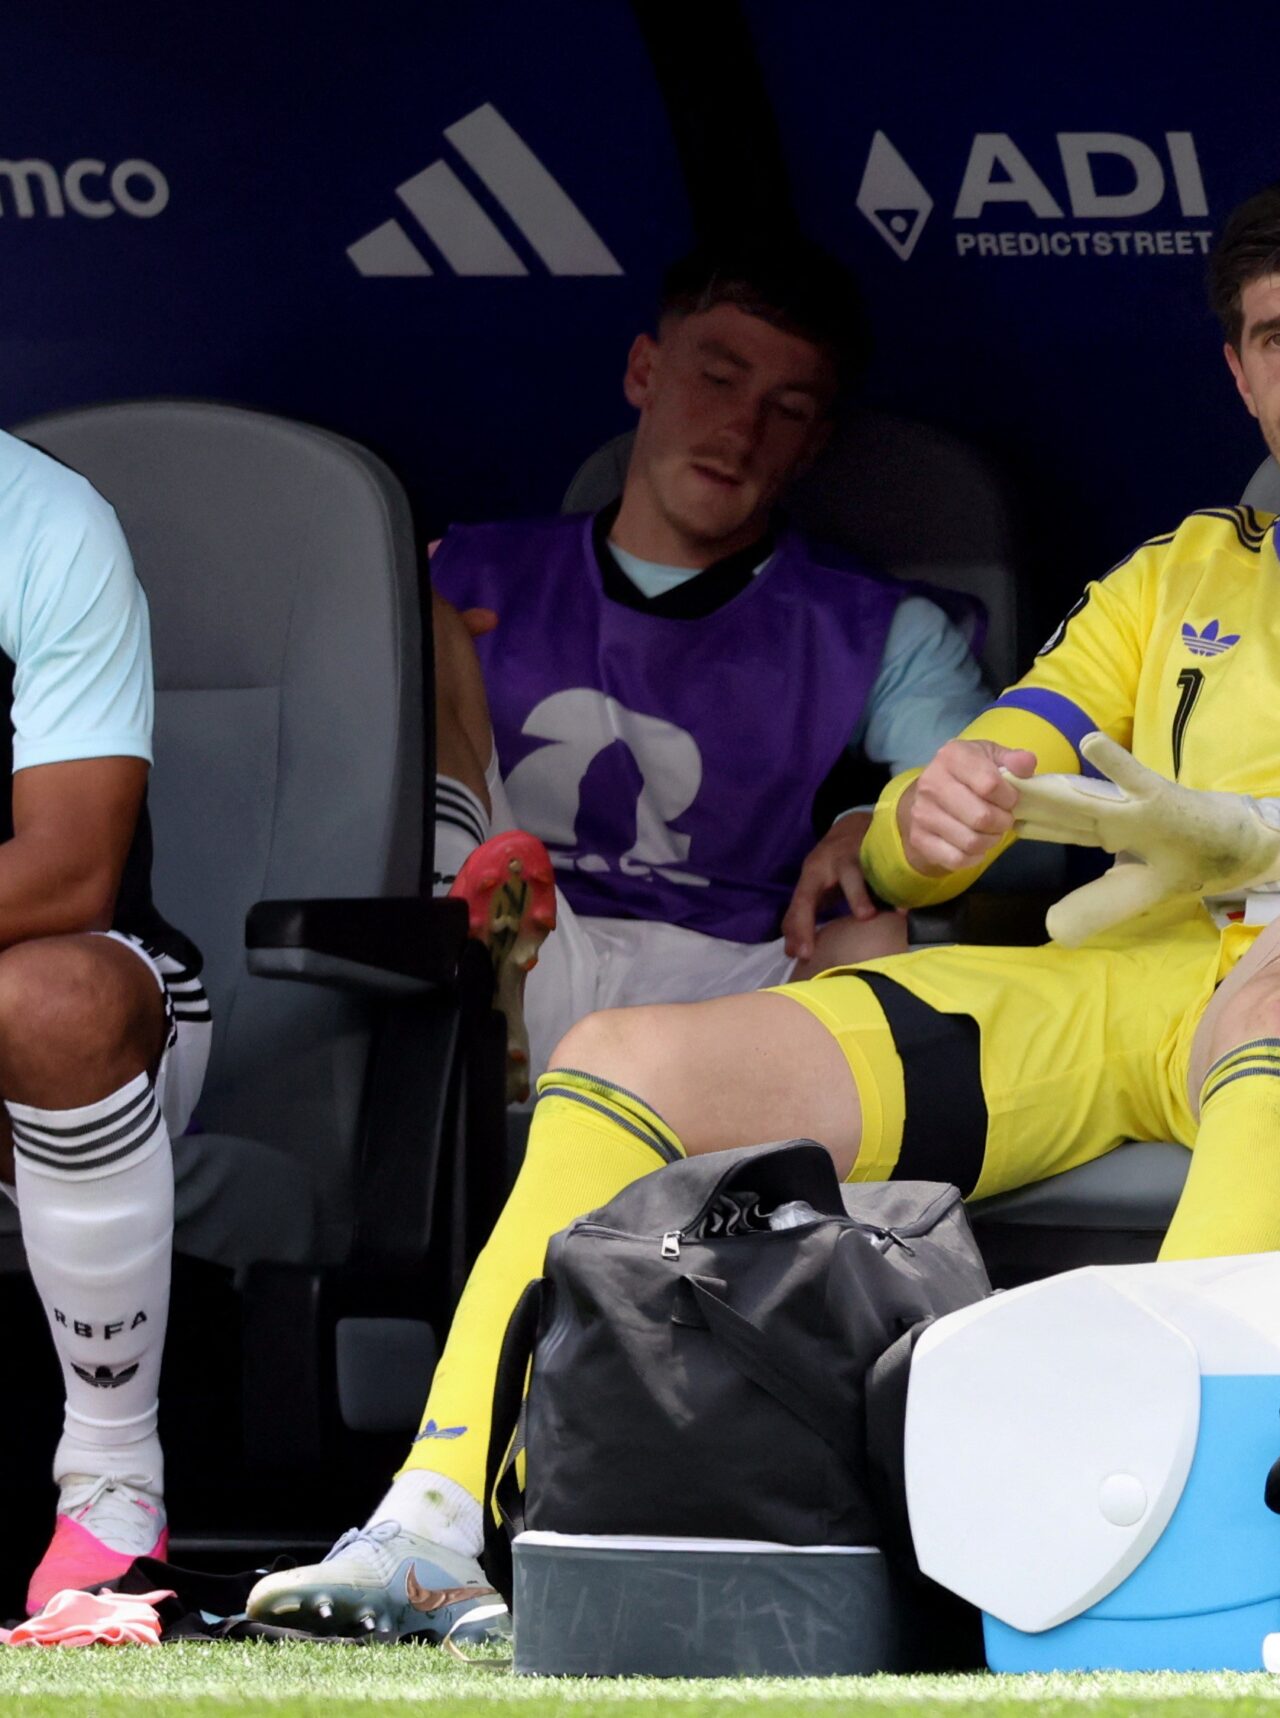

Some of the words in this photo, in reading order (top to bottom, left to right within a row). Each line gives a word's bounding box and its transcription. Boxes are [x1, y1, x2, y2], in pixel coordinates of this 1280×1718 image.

[951, 130, 1210, 220] ADI
[955, 231, 1214, 257] PREDICTSTREET
[54, 1308, 147, 1340] RBFA
